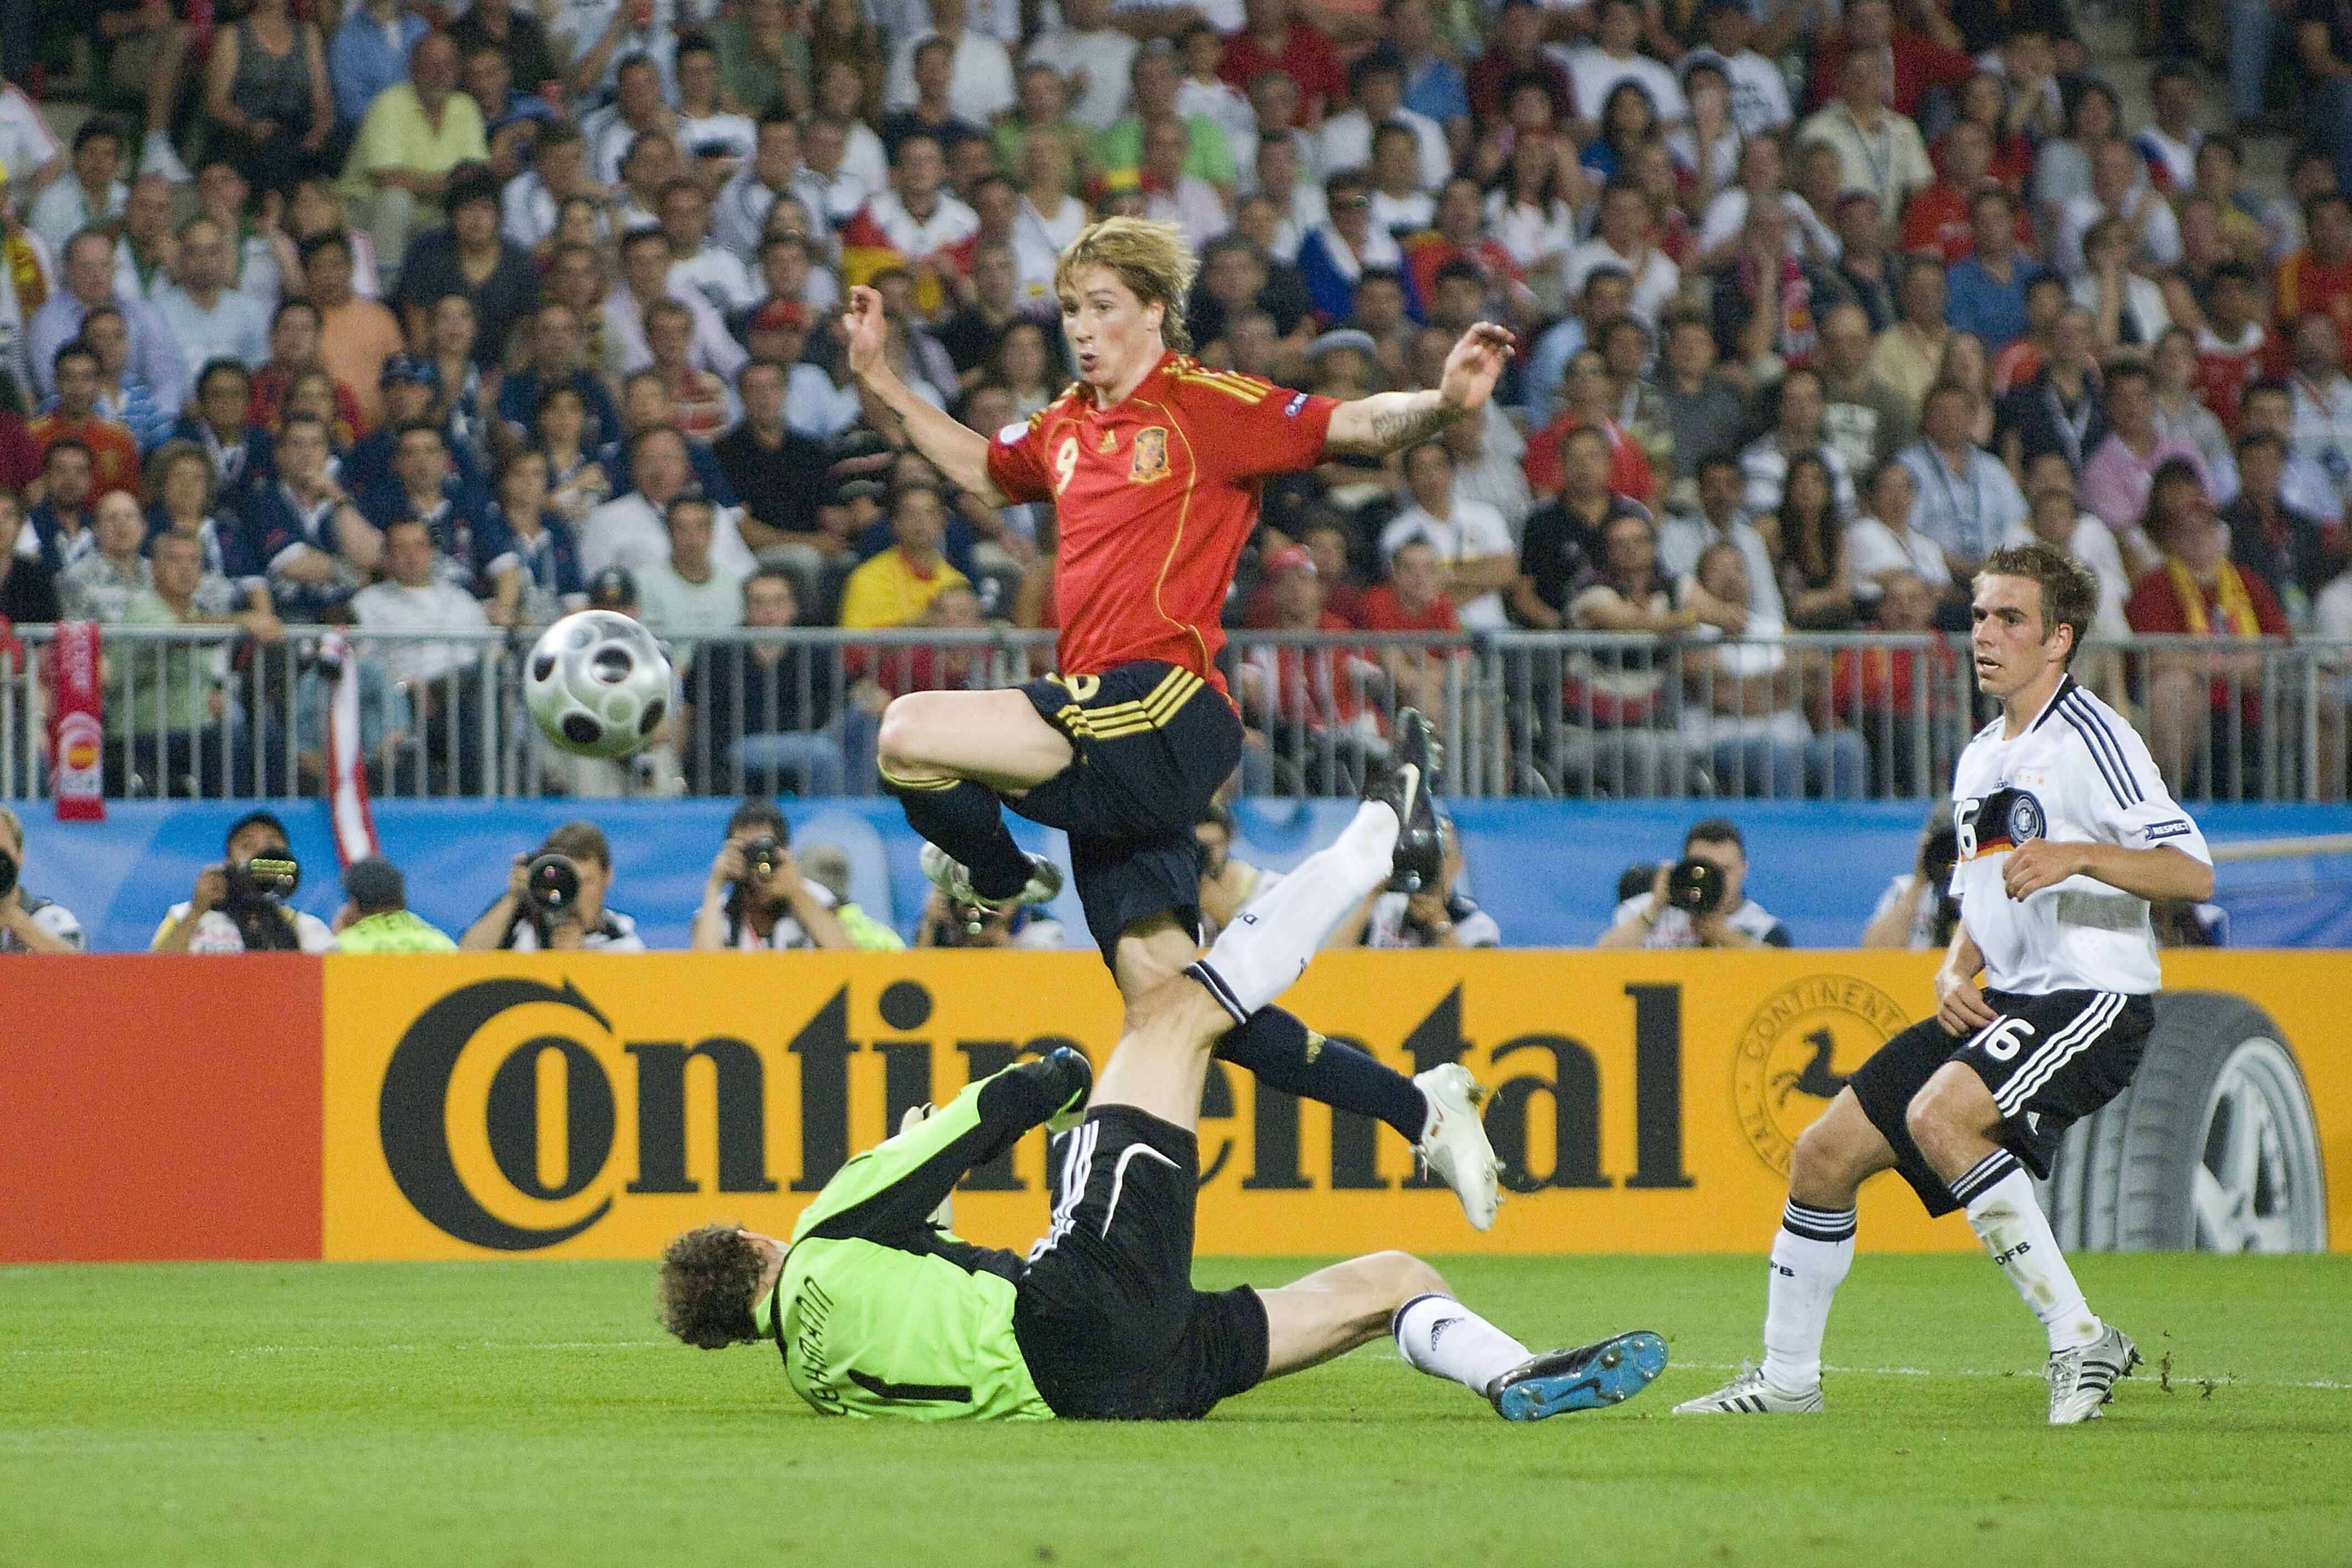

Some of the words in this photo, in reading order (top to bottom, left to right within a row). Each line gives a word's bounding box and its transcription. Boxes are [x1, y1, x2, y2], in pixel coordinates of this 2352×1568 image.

[1057, 436, 1079, 496] 9
[1954, 799, 1980, 860] 6
[2152, 822, 2188, 835] RESPECT
[1968, 1014, 2036, 1061] 16
[1994, 1241, 2031, 1265] DFB
[847, 1368, 972, 1403] 1
